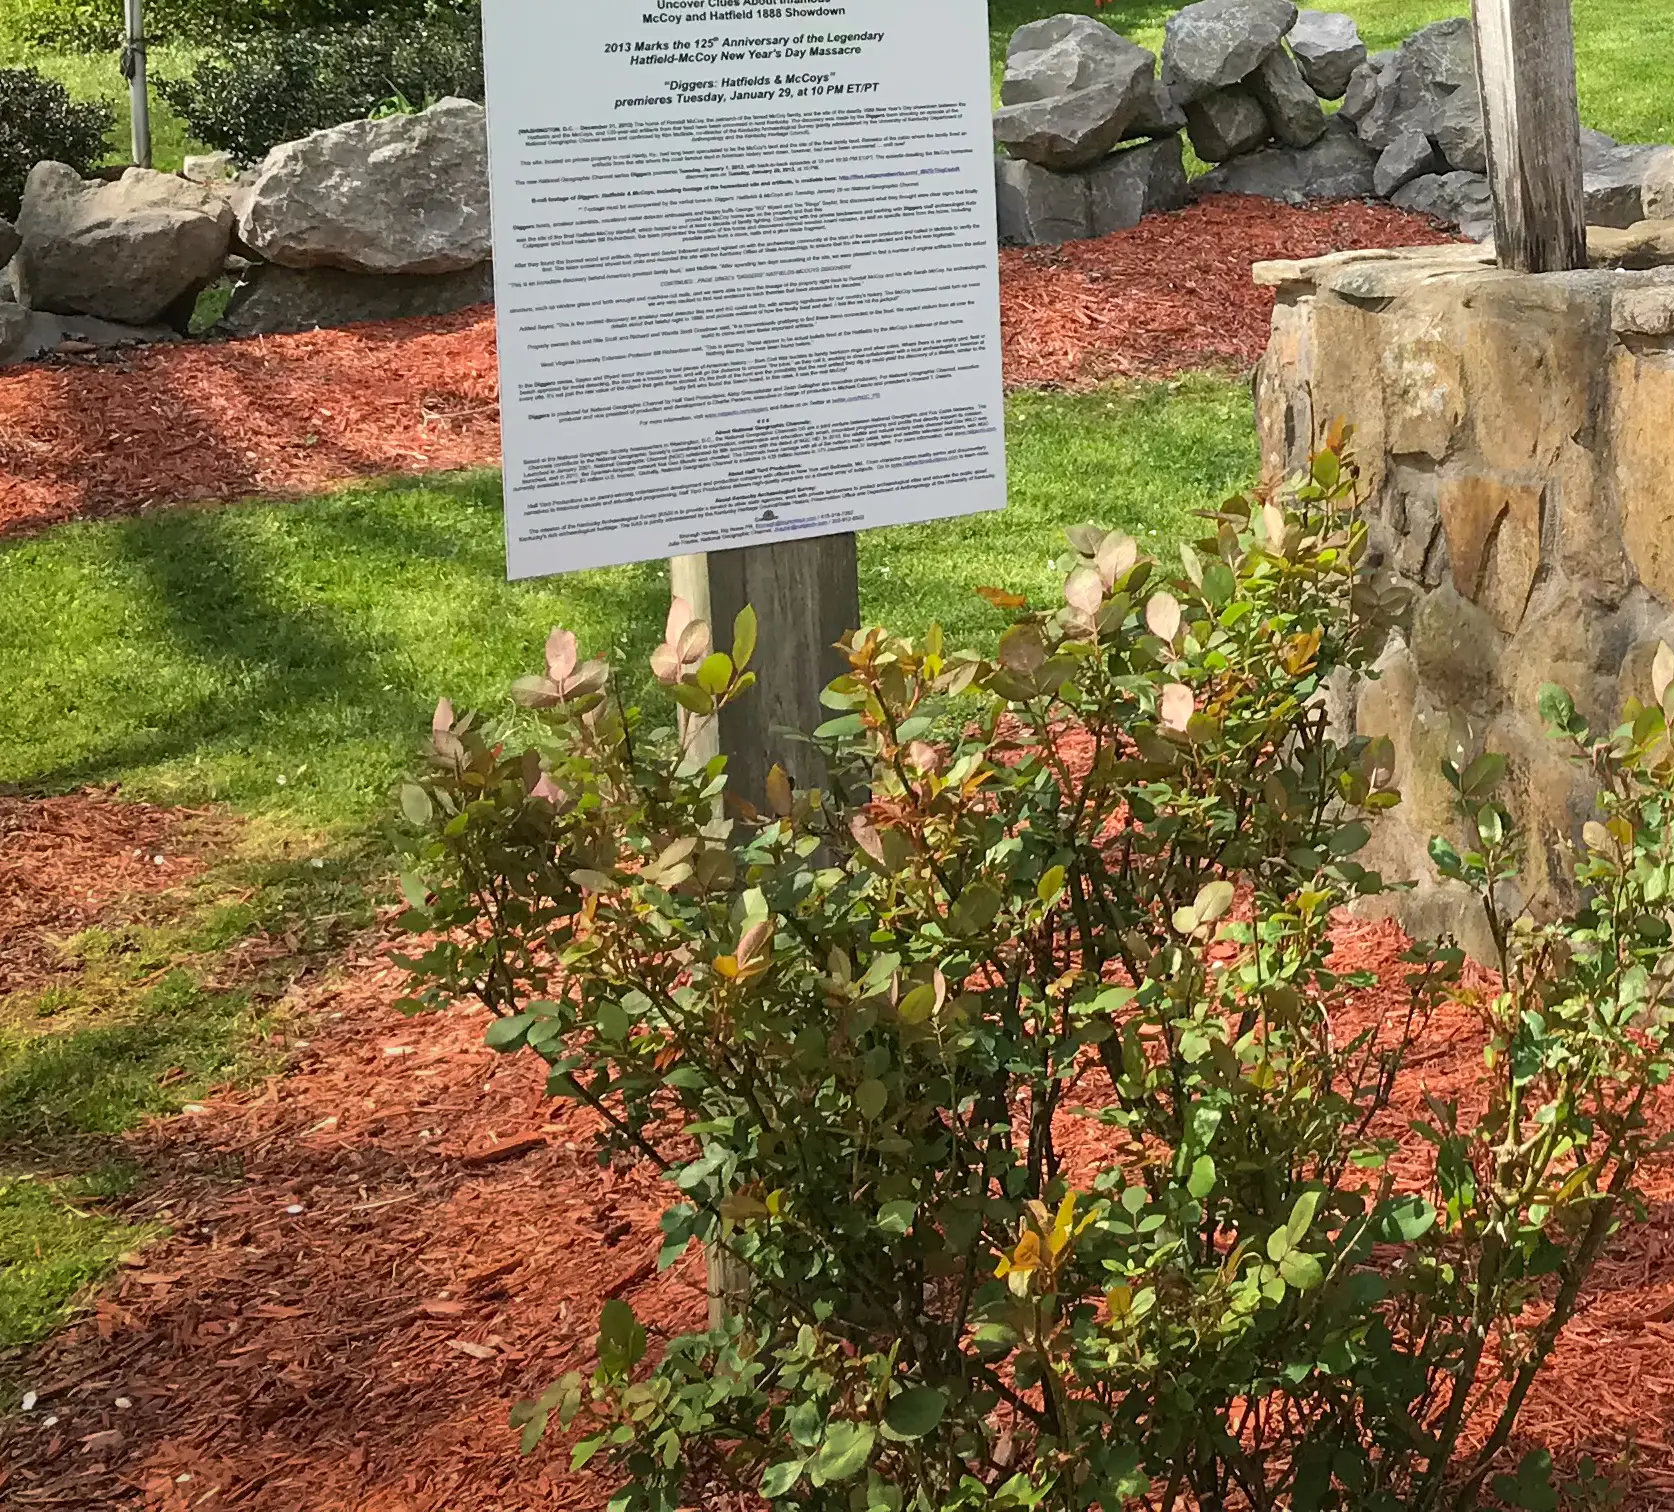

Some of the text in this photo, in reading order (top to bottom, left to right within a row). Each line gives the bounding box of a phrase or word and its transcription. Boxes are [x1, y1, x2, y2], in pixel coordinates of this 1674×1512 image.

[657, 0, 704, 9] Uncover
[642, 6, 845, 24] McCoy and Hatfield 1888 Showdown
[604, 42, 631, 53] 2013
[634, 41, 669, 51] Marks
[673, 40, 690, 49] the
[722, 37, 789, 46] Anniversary
[792, 34, 804, 43] of
[806, 33, 824, 43] the
[827, 31, 884, 44] Legendary
[630, 52, 717, 65] Hatfield-McCoy
[720, 51, 745, 60] New
[785, 47, 806, 59] Day
[809, 46, 861, 56] Massacre
[721, 76, 770, 87] Hatfields
[774, 74, 781, 84] &
[614, 82, 879, 109] premieres Tuesday, January 29, at 10 PM ET/PT
